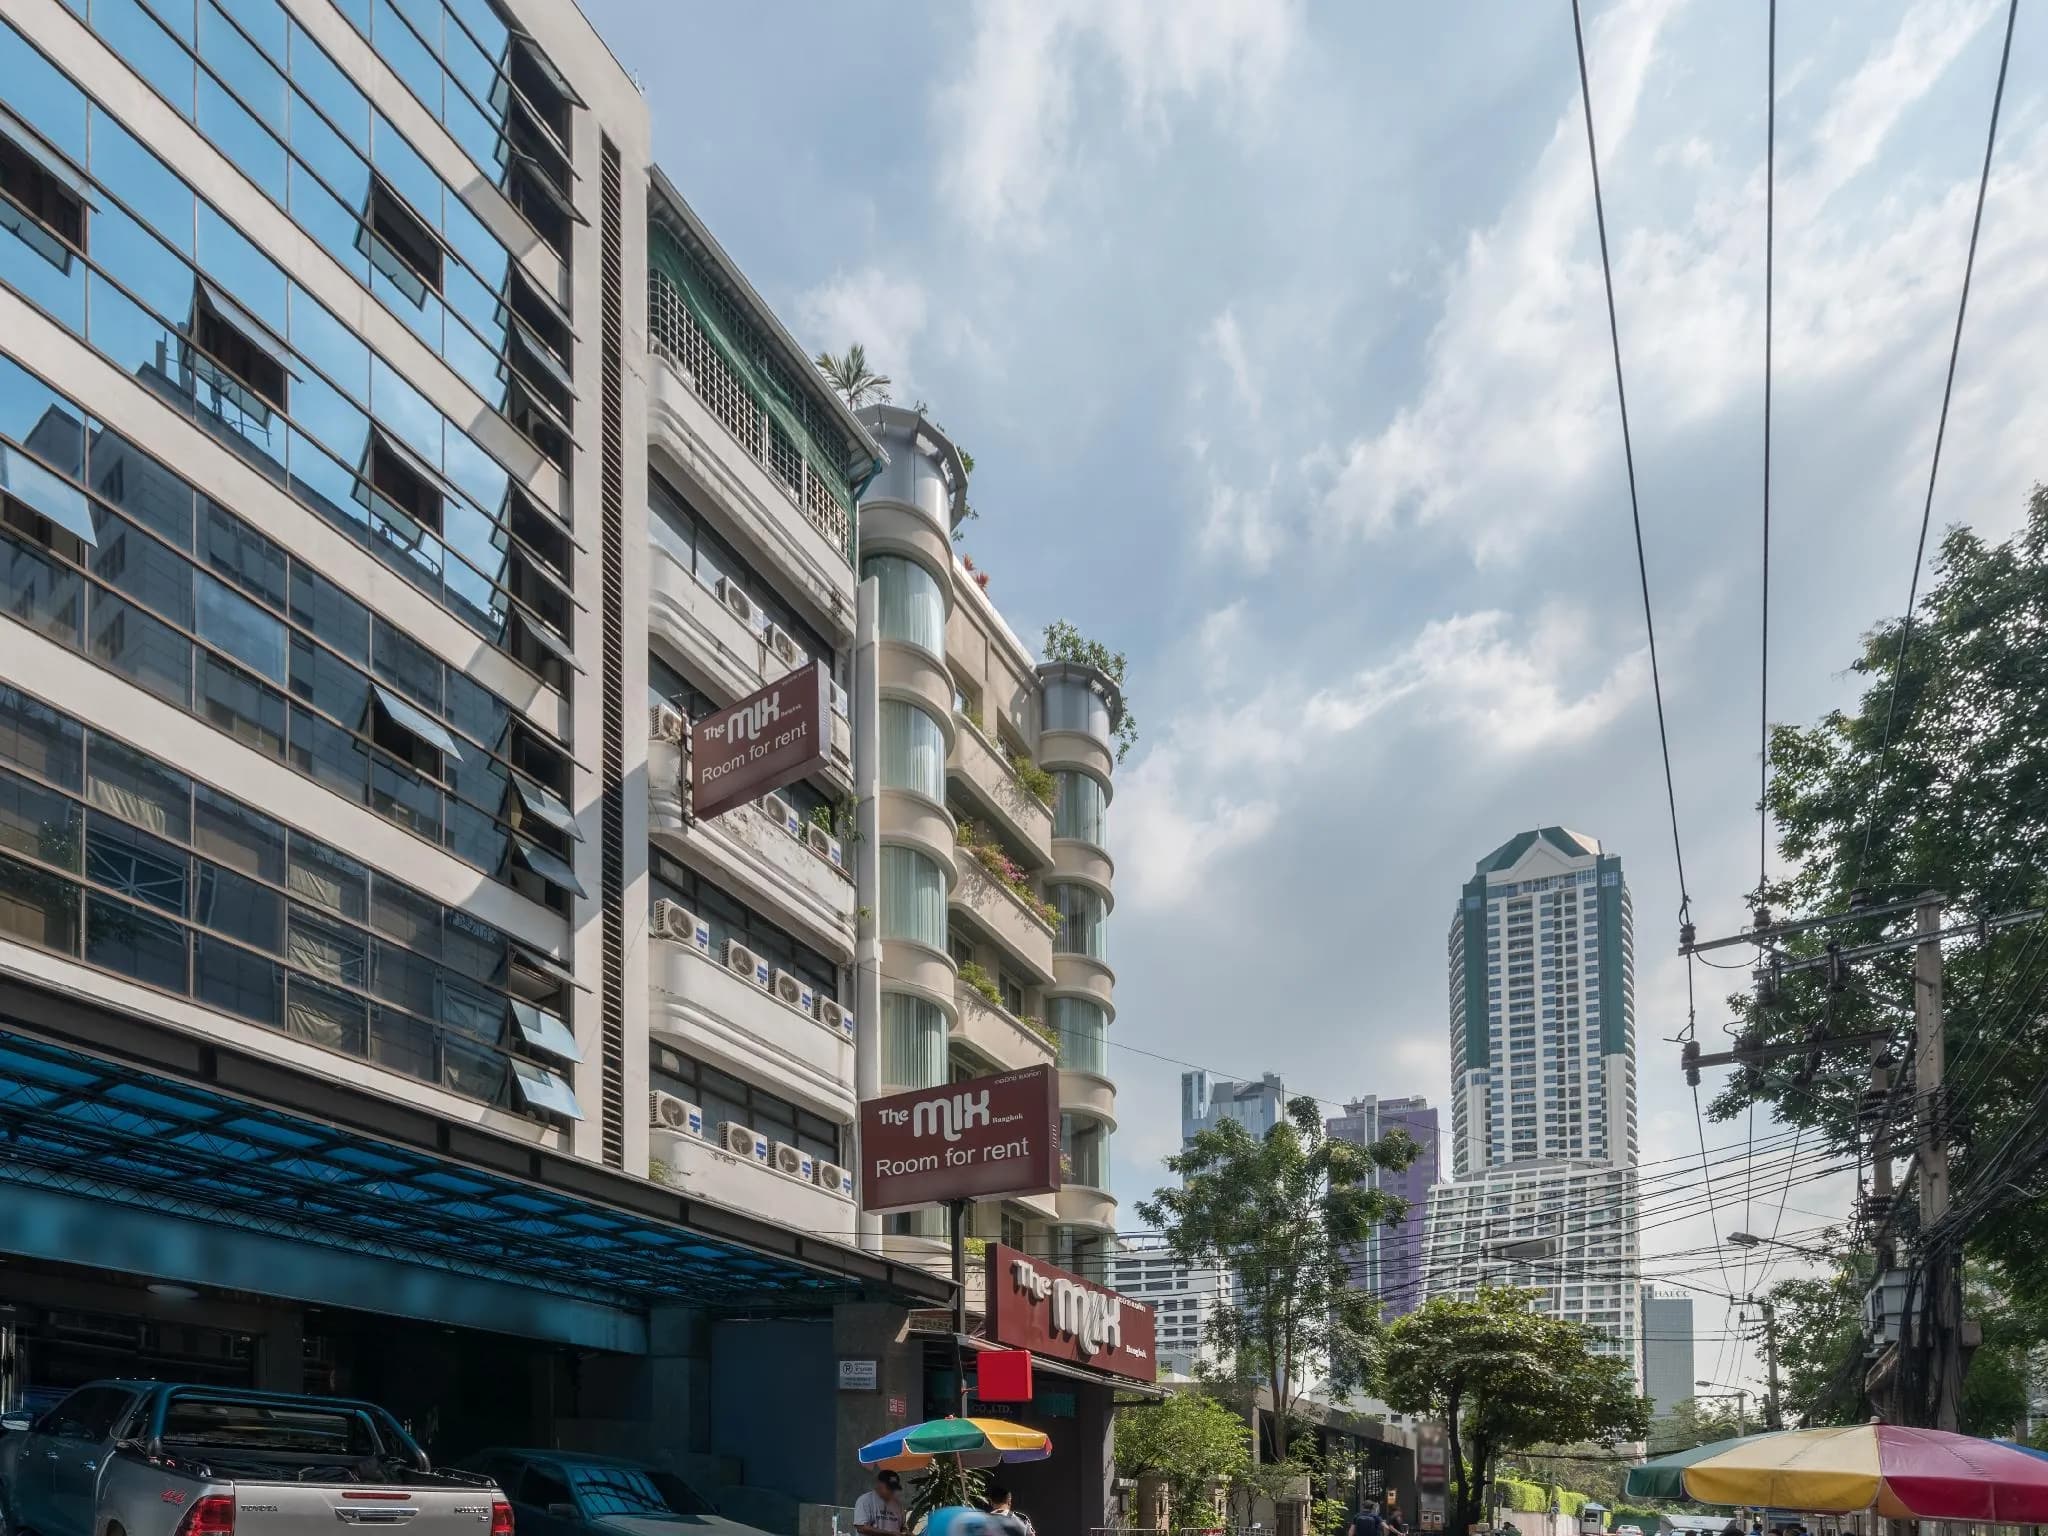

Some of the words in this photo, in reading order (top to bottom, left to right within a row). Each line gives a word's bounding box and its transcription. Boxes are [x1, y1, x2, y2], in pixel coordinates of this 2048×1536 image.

[702, 753, 745, 784] Room
[749, 740, 771, 761] for
[775, 720, 808, 749] rent
[703, 723, 726, 741] The
[878, 1108, 909, 1126] The
[876, 1154, 938, 1178] Room
[945, 1147, 976, 1167] for
[983, 1136, 1030, 1162] rent
[1011, 1259, 1051, 1300] The
